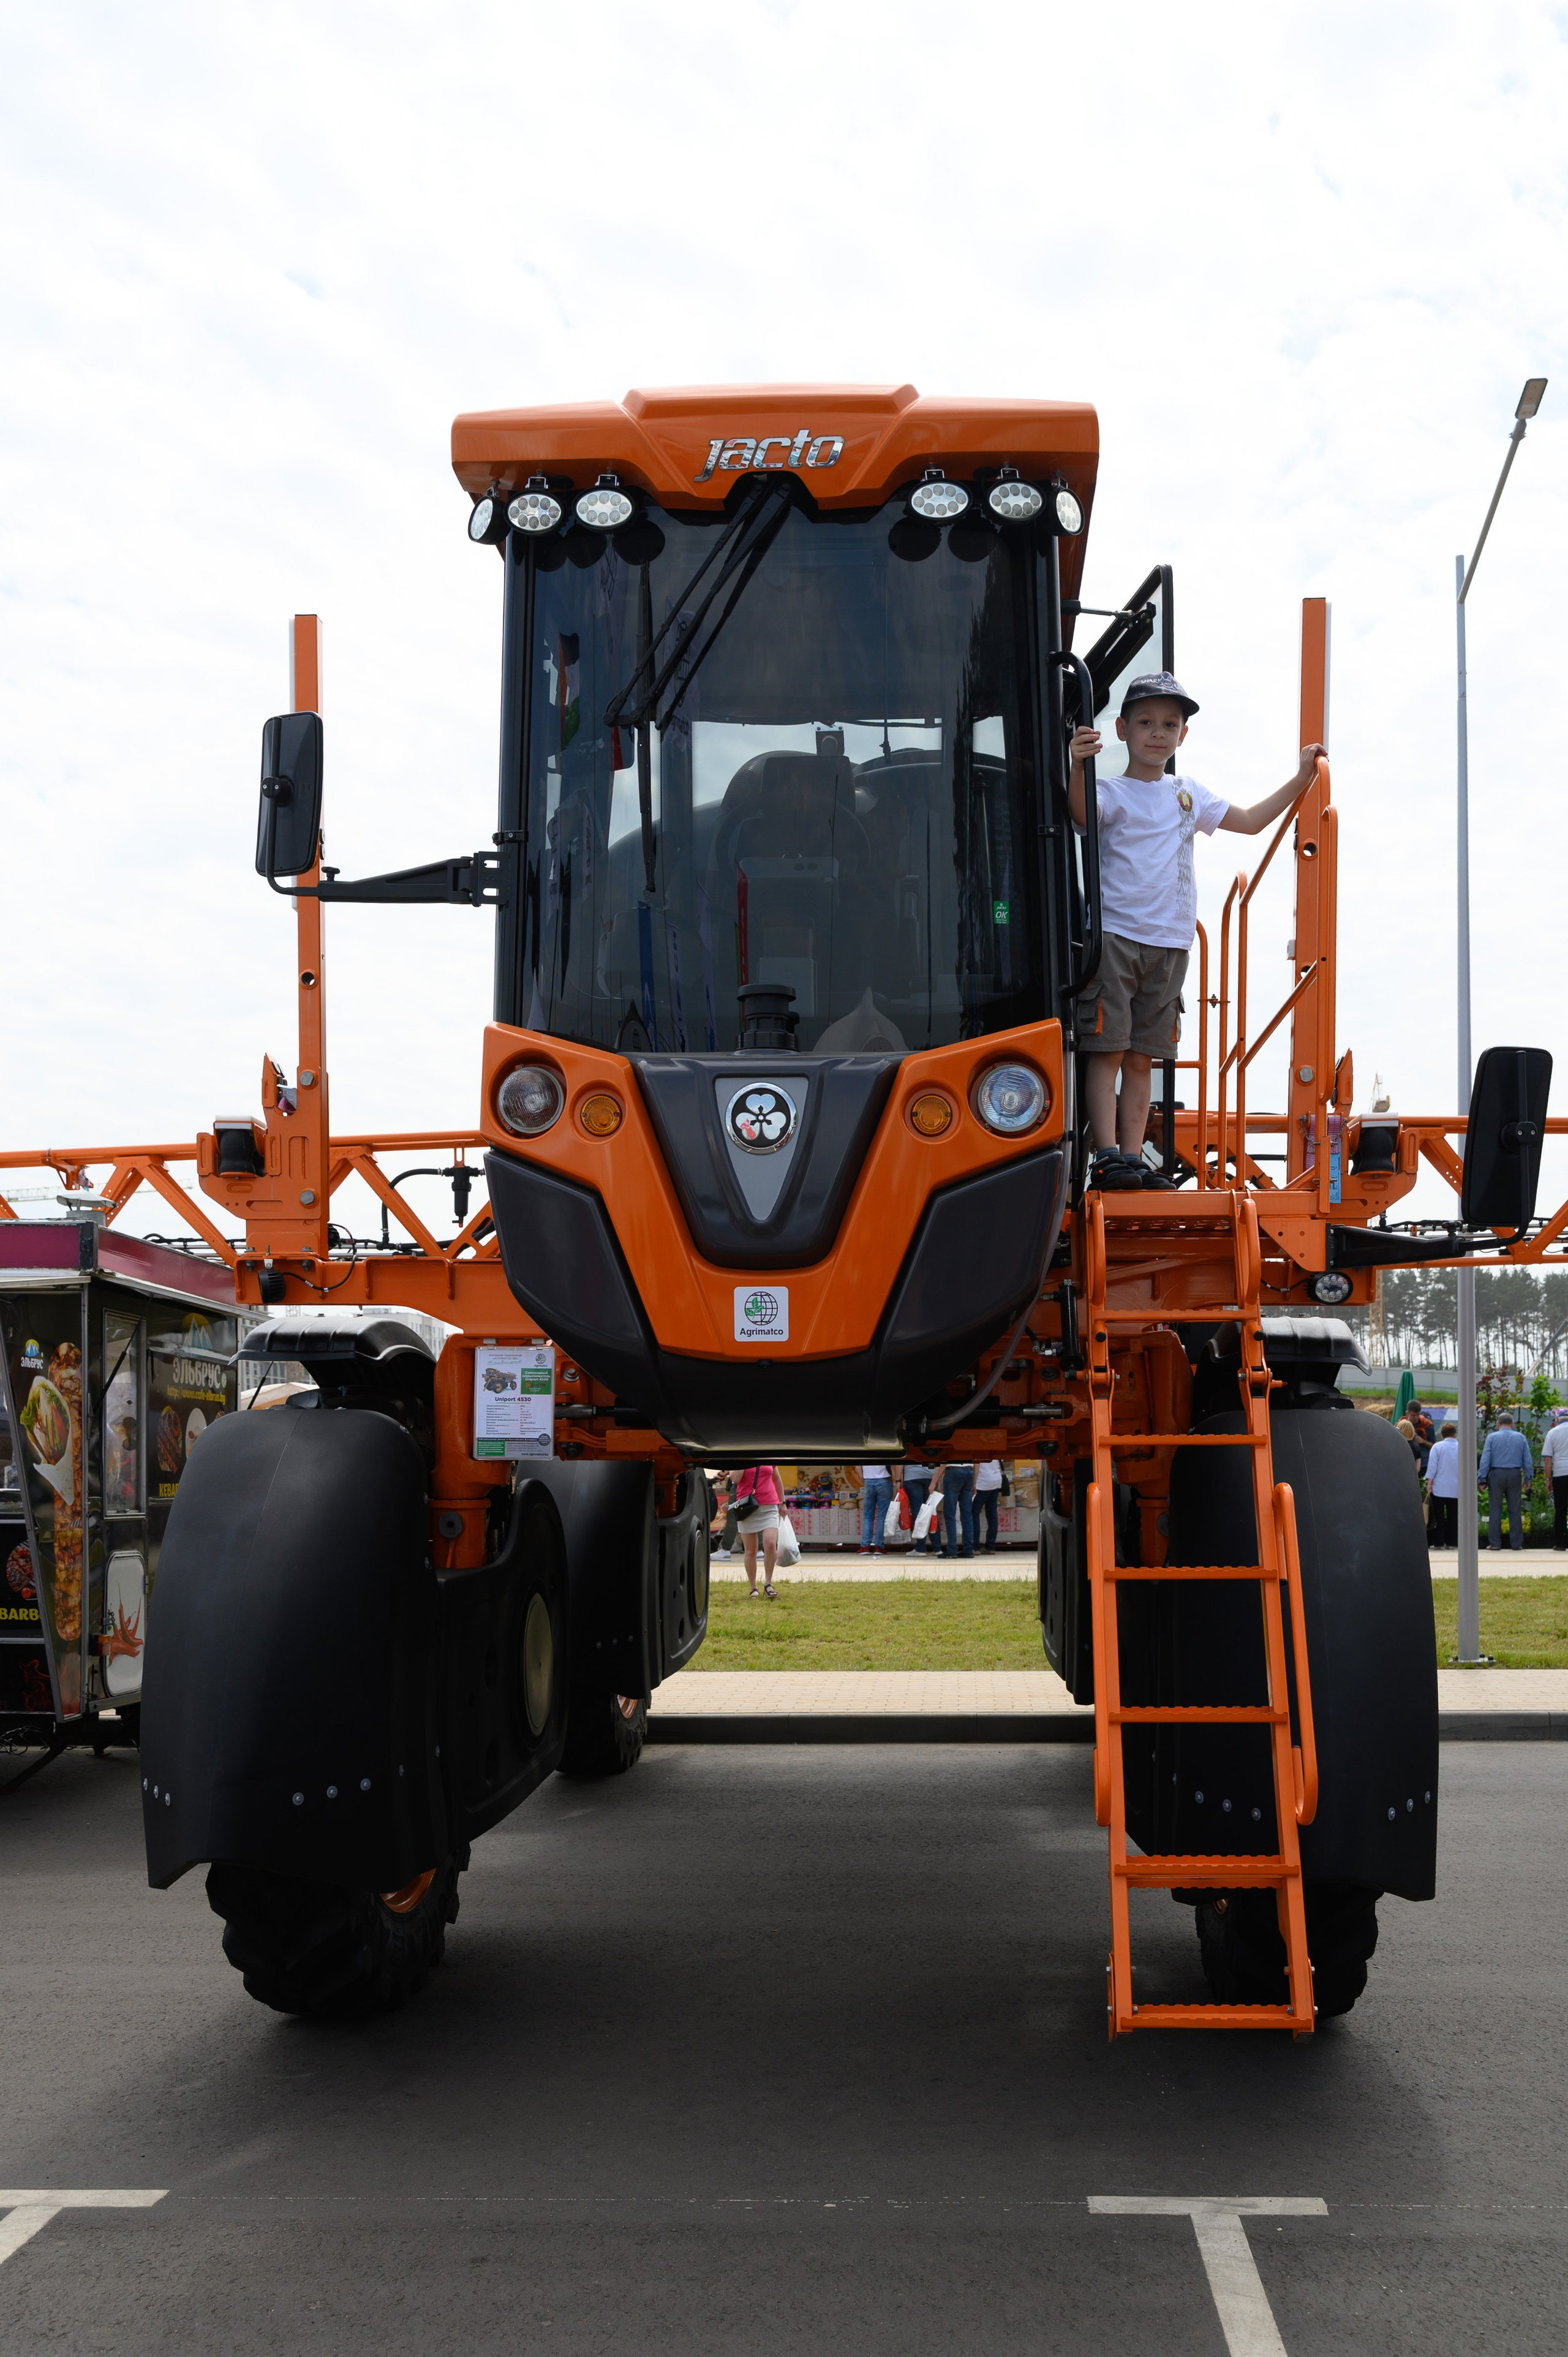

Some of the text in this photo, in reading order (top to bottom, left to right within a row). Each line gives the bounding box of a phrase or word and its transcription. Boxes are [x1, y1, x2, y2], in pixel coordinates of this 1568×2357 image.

[693, 429, 845, 483] jacto
[739, 1327, 784, 1337] Agrimatco
[21, 1357, 43, 1370] ЭЛЬБРУС
[173, 1357, 221, 1389] ЭЛЬБРУС
[0, 1608, 40, 1621] BARB
